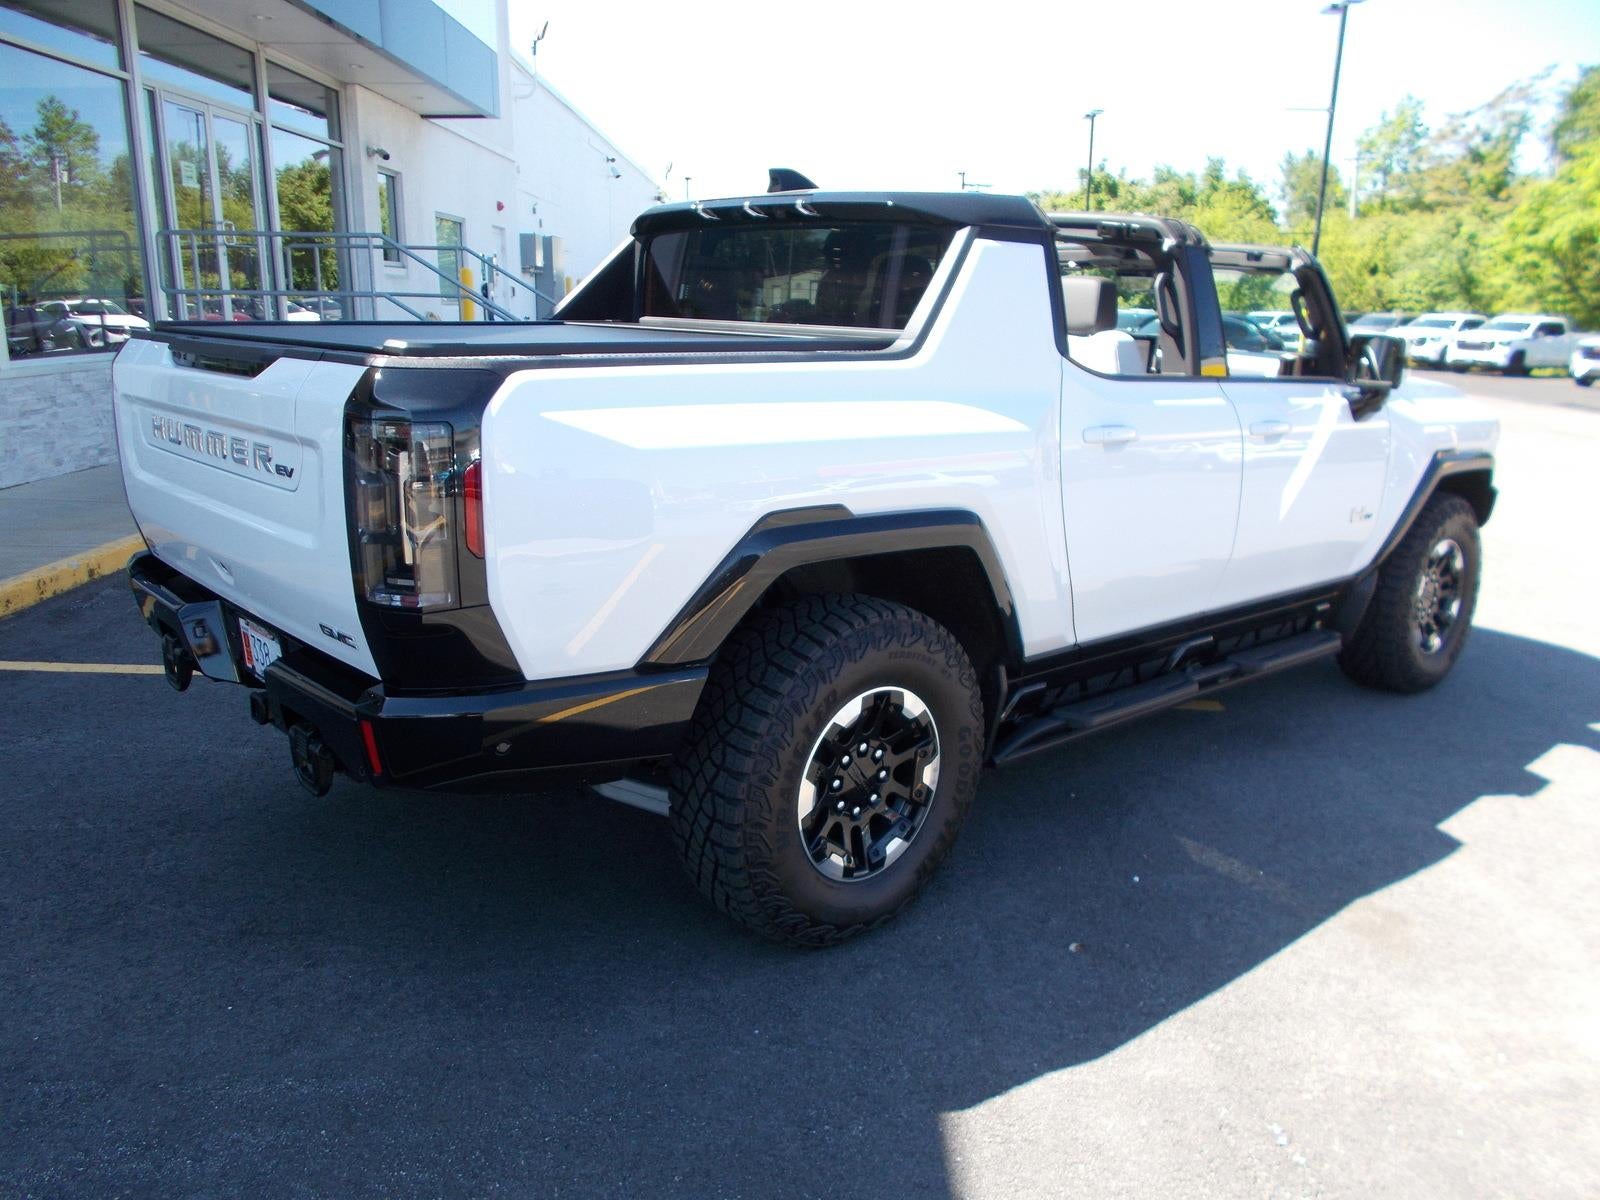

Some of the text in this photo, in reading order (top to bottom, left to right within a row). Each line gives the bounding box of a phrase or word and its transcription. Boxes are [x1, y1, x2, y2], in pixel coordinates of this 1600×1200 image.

[152, 415, 295, 478] HUMMER EV
[318, 623, 358, 650] GMC
